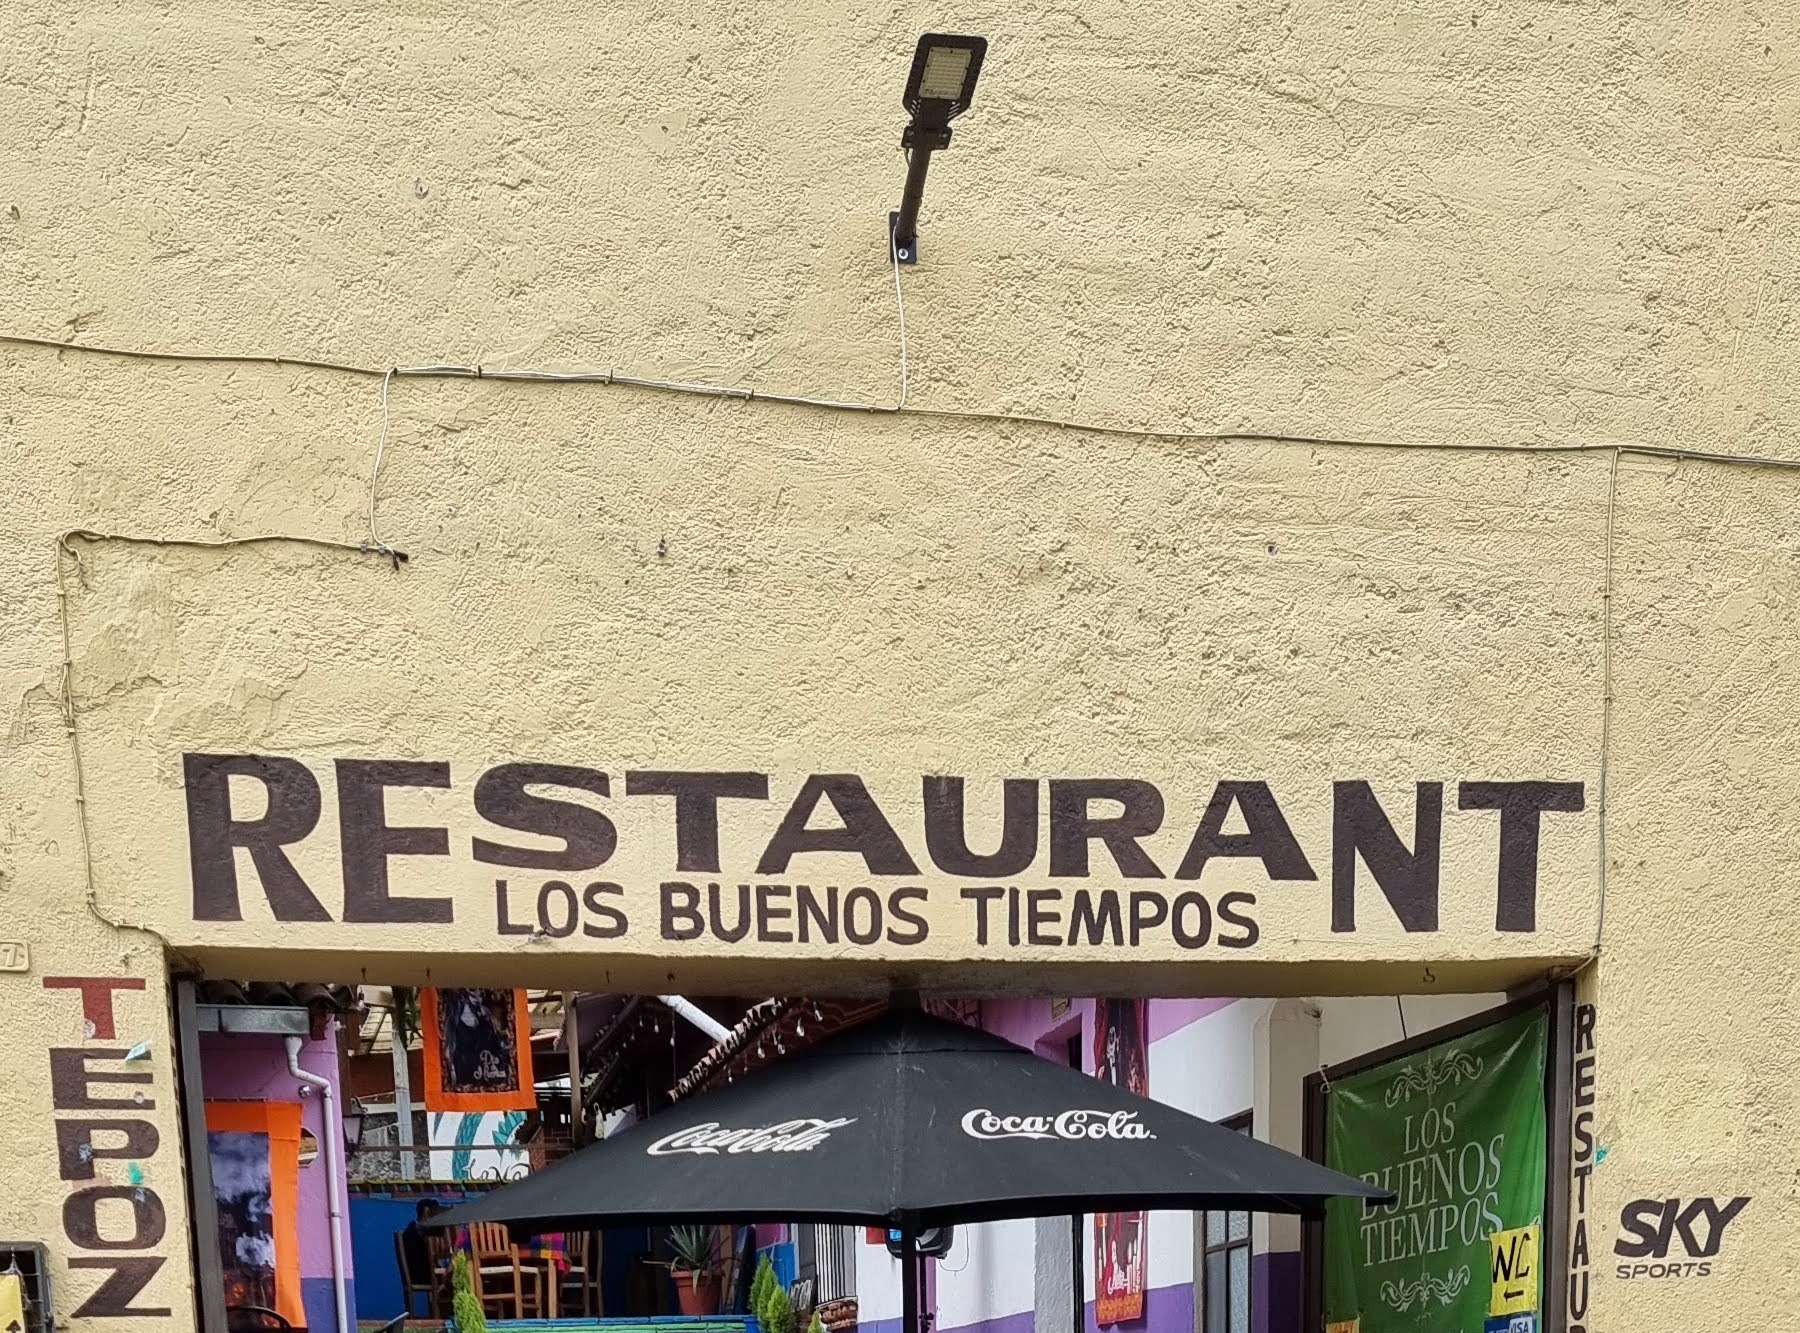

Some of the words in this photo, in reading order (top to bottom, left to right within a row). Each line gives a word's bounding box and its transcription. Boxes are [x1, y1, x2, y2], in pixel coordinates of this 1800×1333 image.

[183, 752, 1585, 932] RESTAURANT
[495, 879, 630, 940] LOS
[659, 882, 930, 944] BUENOS
[960, 886, 1261, 949] TIEMPOS
[43, 976, 171, 1319] TEPOZ
[961, 1108, 1158, 1140] Coca-Cola
[1402, 1101, 1457, 1155] LOS
[1360, 1191, 1504, 1267] TIEMPOS
[1490, 1232, 1532, 1284] WC
[1613, 1196, 1753, 1259] SKY
[1615, 1261, 1713, 1280] SPORTS
